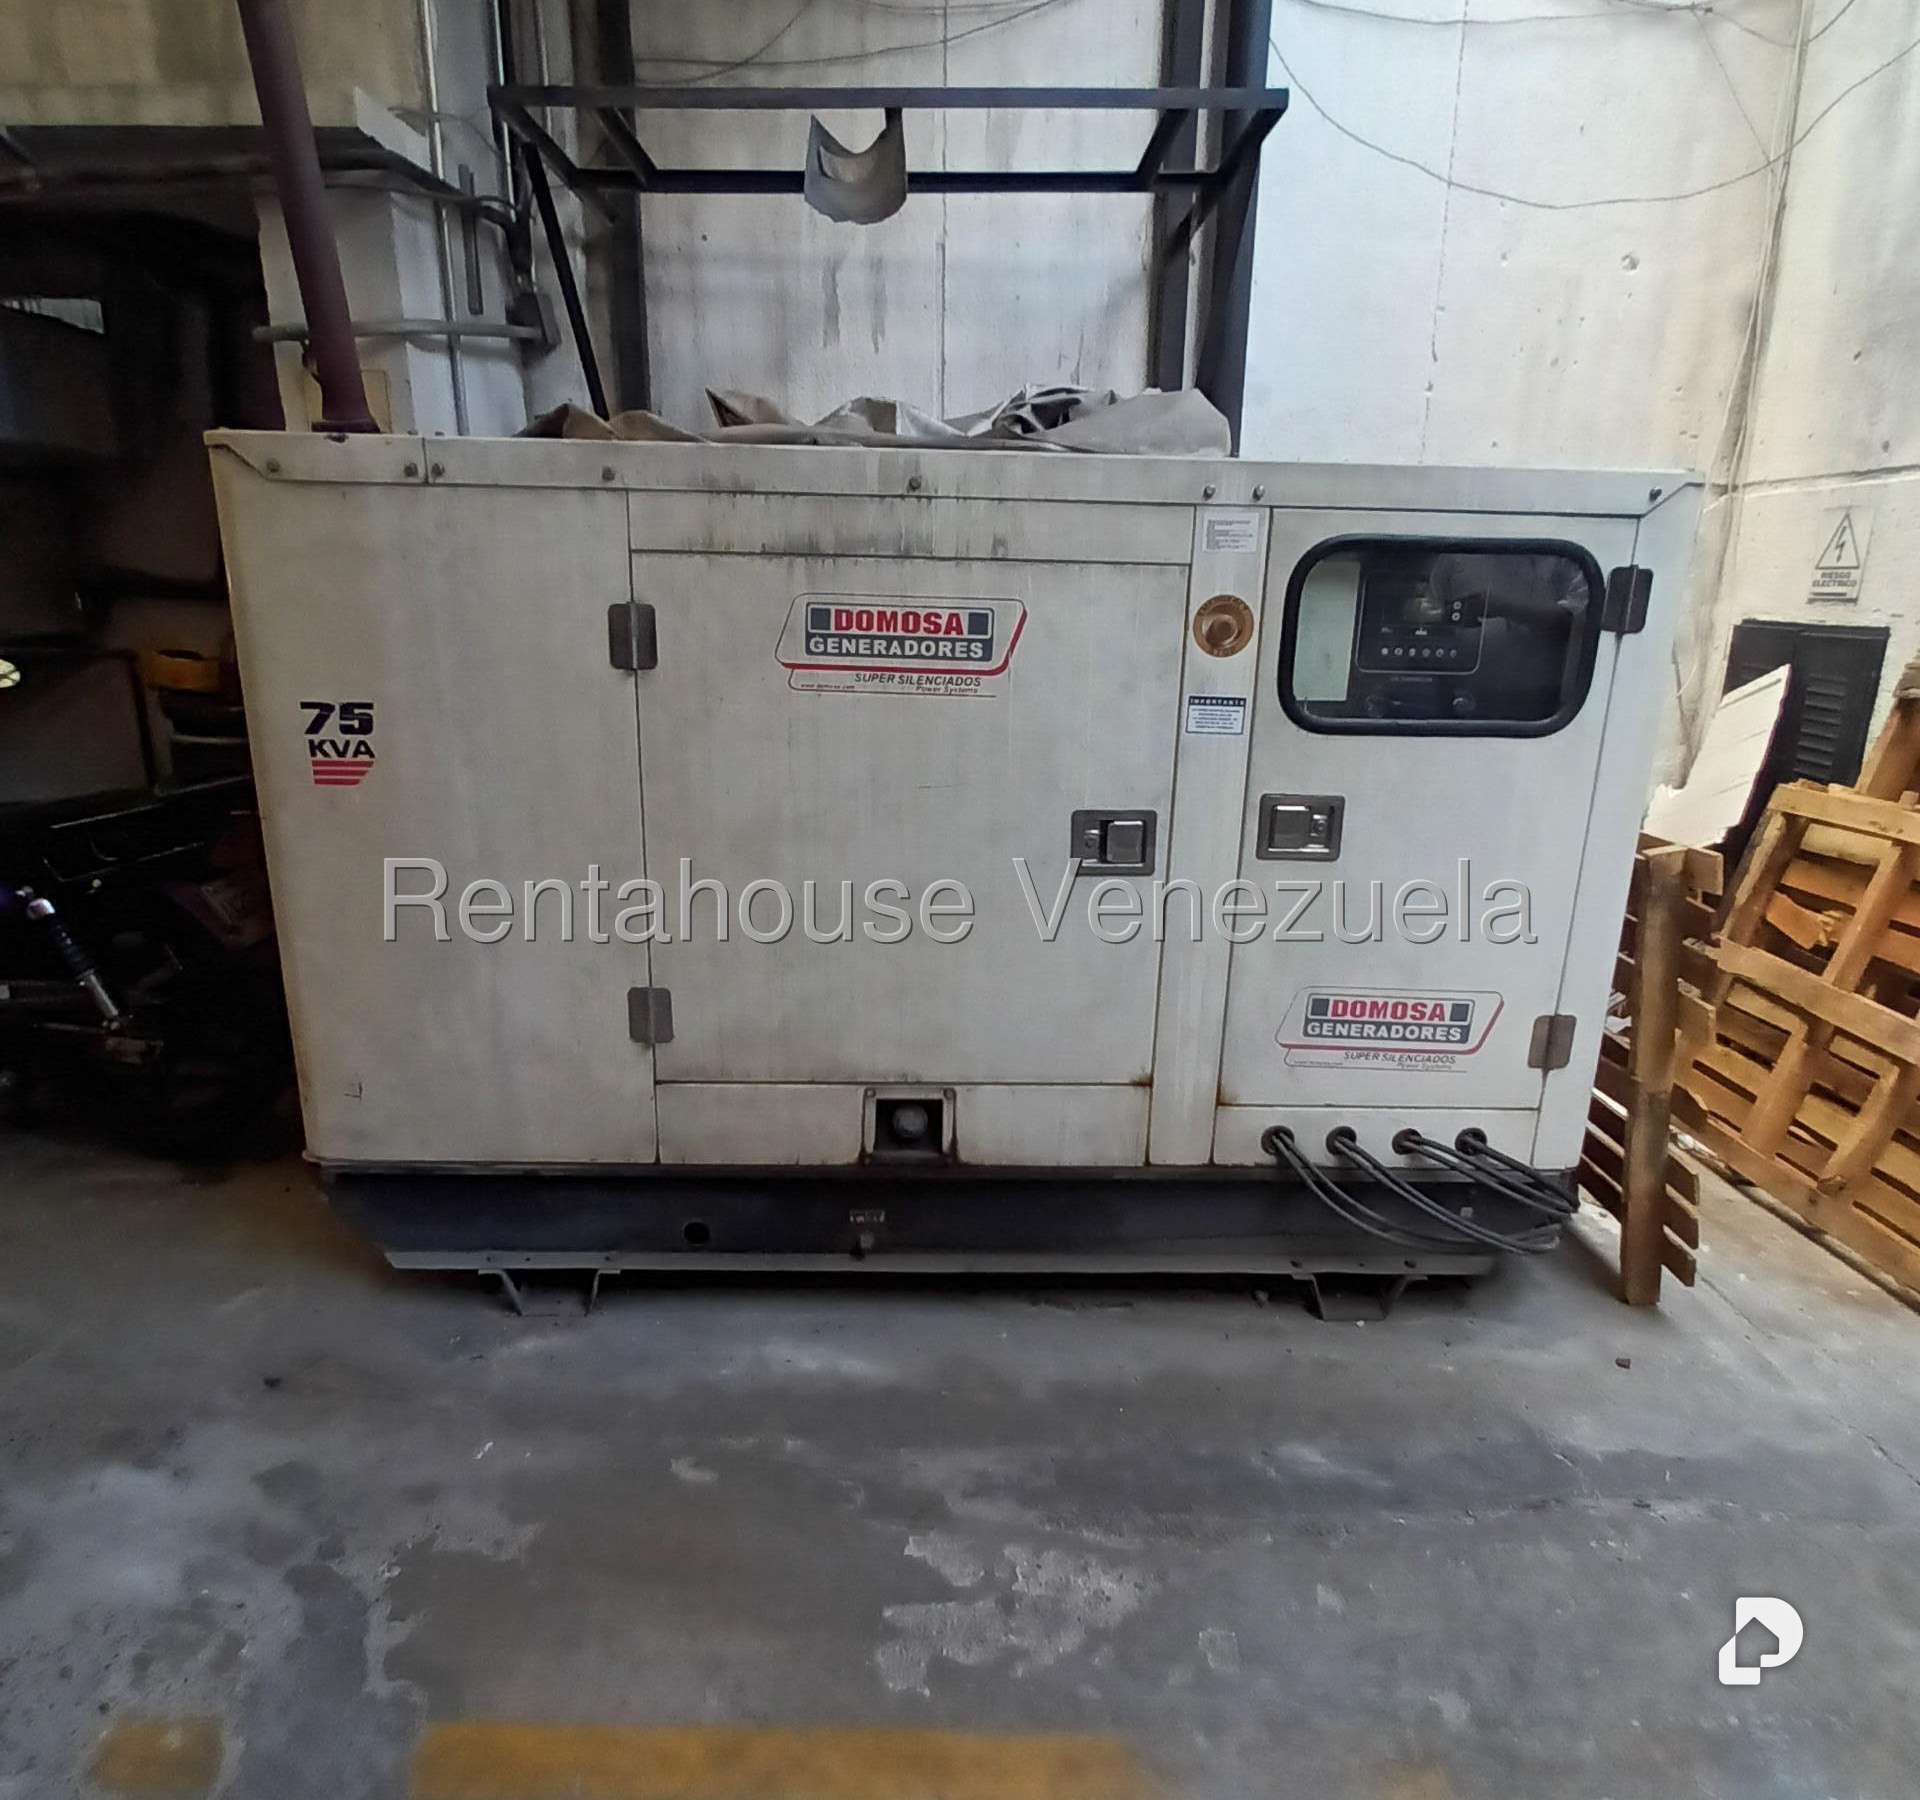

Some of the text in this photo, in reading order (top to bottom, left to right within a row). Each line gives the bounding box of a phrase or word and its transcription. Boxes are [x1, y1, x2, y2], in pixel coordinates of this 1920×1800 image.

[834, 609, 964, 635] DOMOSA
[809, 637, 984, 658] GENERADORES
[854, 672, 982, 687] SUPER SILENCIADOS
[300, 702, 374, 735] 75
[308, 739, 375, 758] KVA
[1331, 1000, 1446, 1022] DOMOSA
[1306, 1022, 1462, 1041] GENERADORES
[1343, 1051, 1457, 1065] SUPER SILENCIADOS
